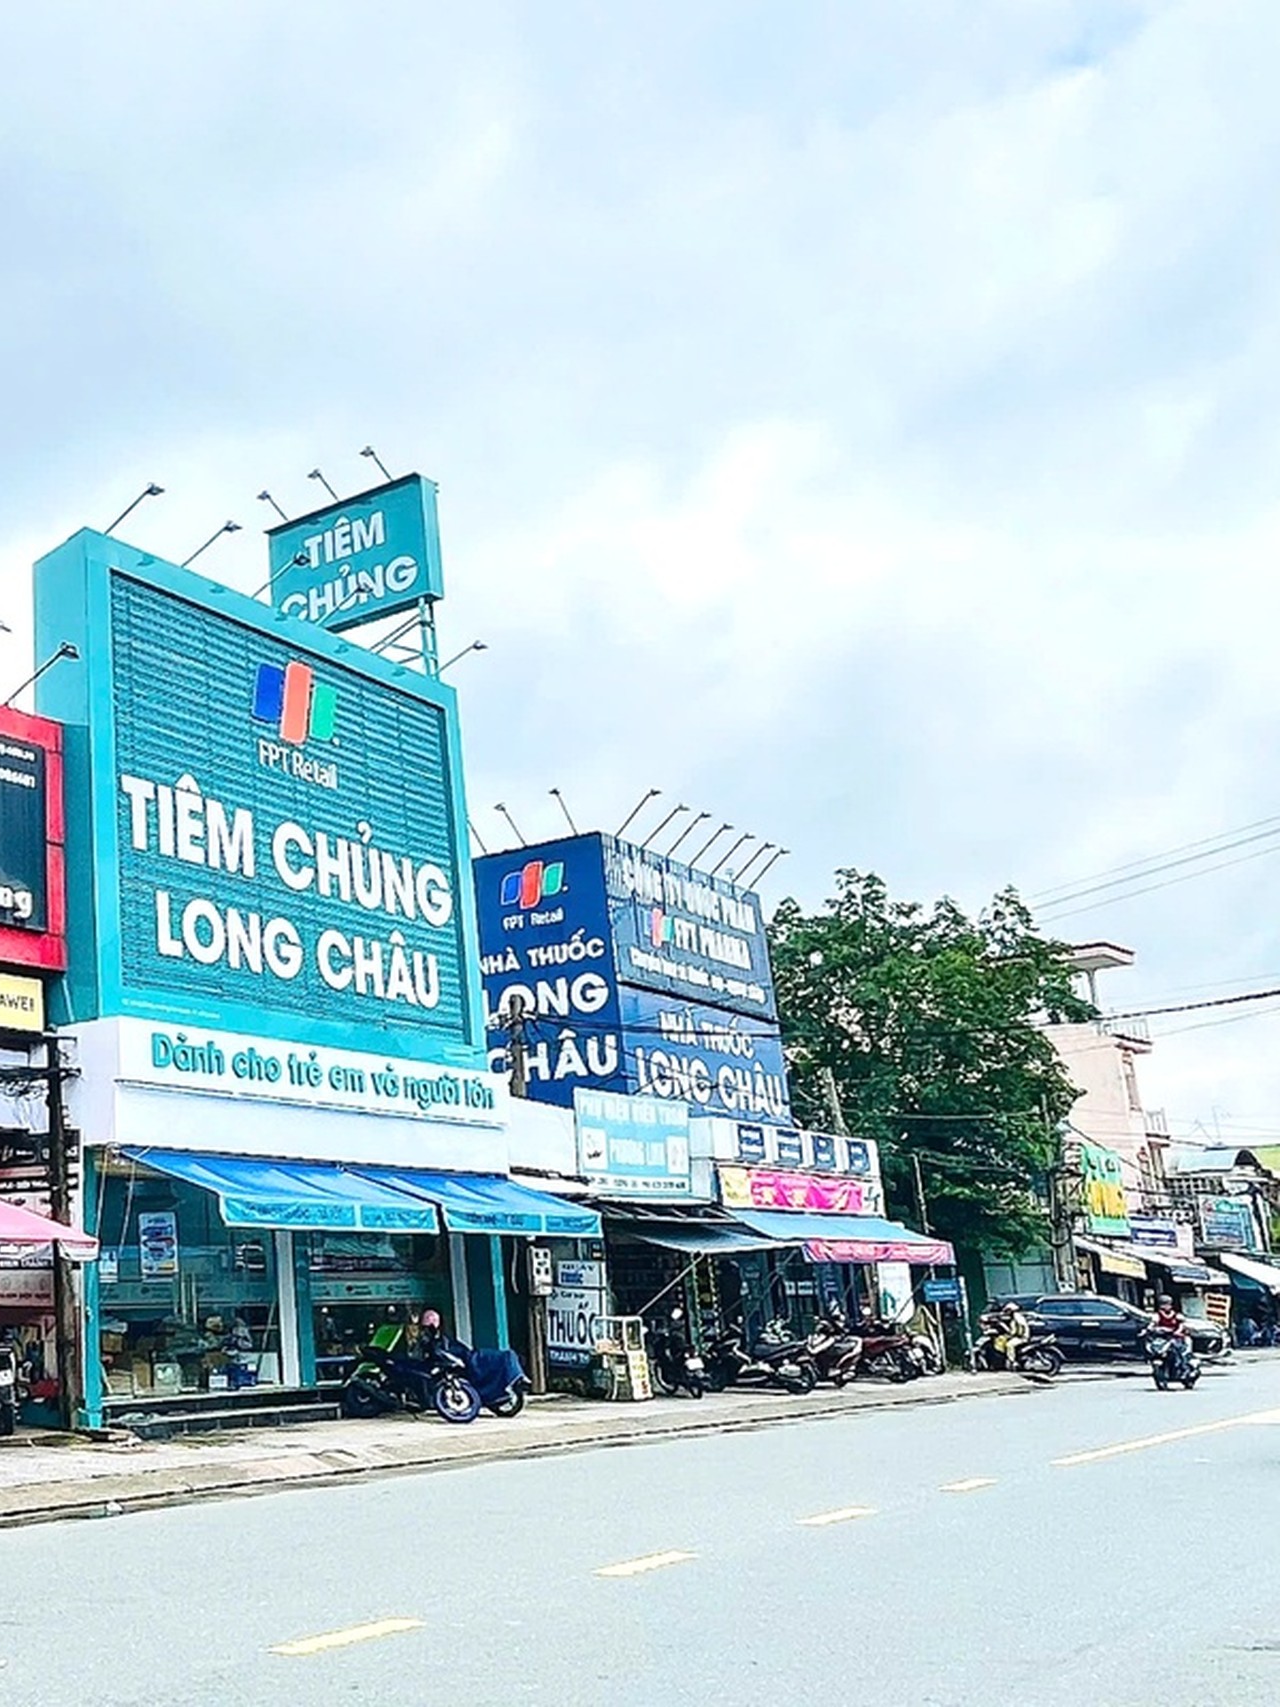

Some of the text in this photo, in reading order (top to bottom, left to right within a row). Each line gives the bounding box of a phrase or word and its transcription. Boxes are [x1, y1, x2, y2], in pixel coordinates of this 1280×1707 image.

[280, 511, 418, 622] TIÊM CHỦNG
[258, 738, 339, 790] FPT Retail
[120, 773, 454, 927] TIÊM CHỦNG
[155, 889, 441, 1009] LONG CHÂU
[503, 907, 564, 932] FPT Retail
[480, 928, 605, 976] NHÀ THUỐC
[487, 1028, 618, 1083] CHÂU
[659, 1009, 754, 1059] NHÀ THUỐC
[151, 1032, 496, 1111] Dành cho trẻ em và người lớn
[635, 1046, 788, 1118] LONG CHÂU
